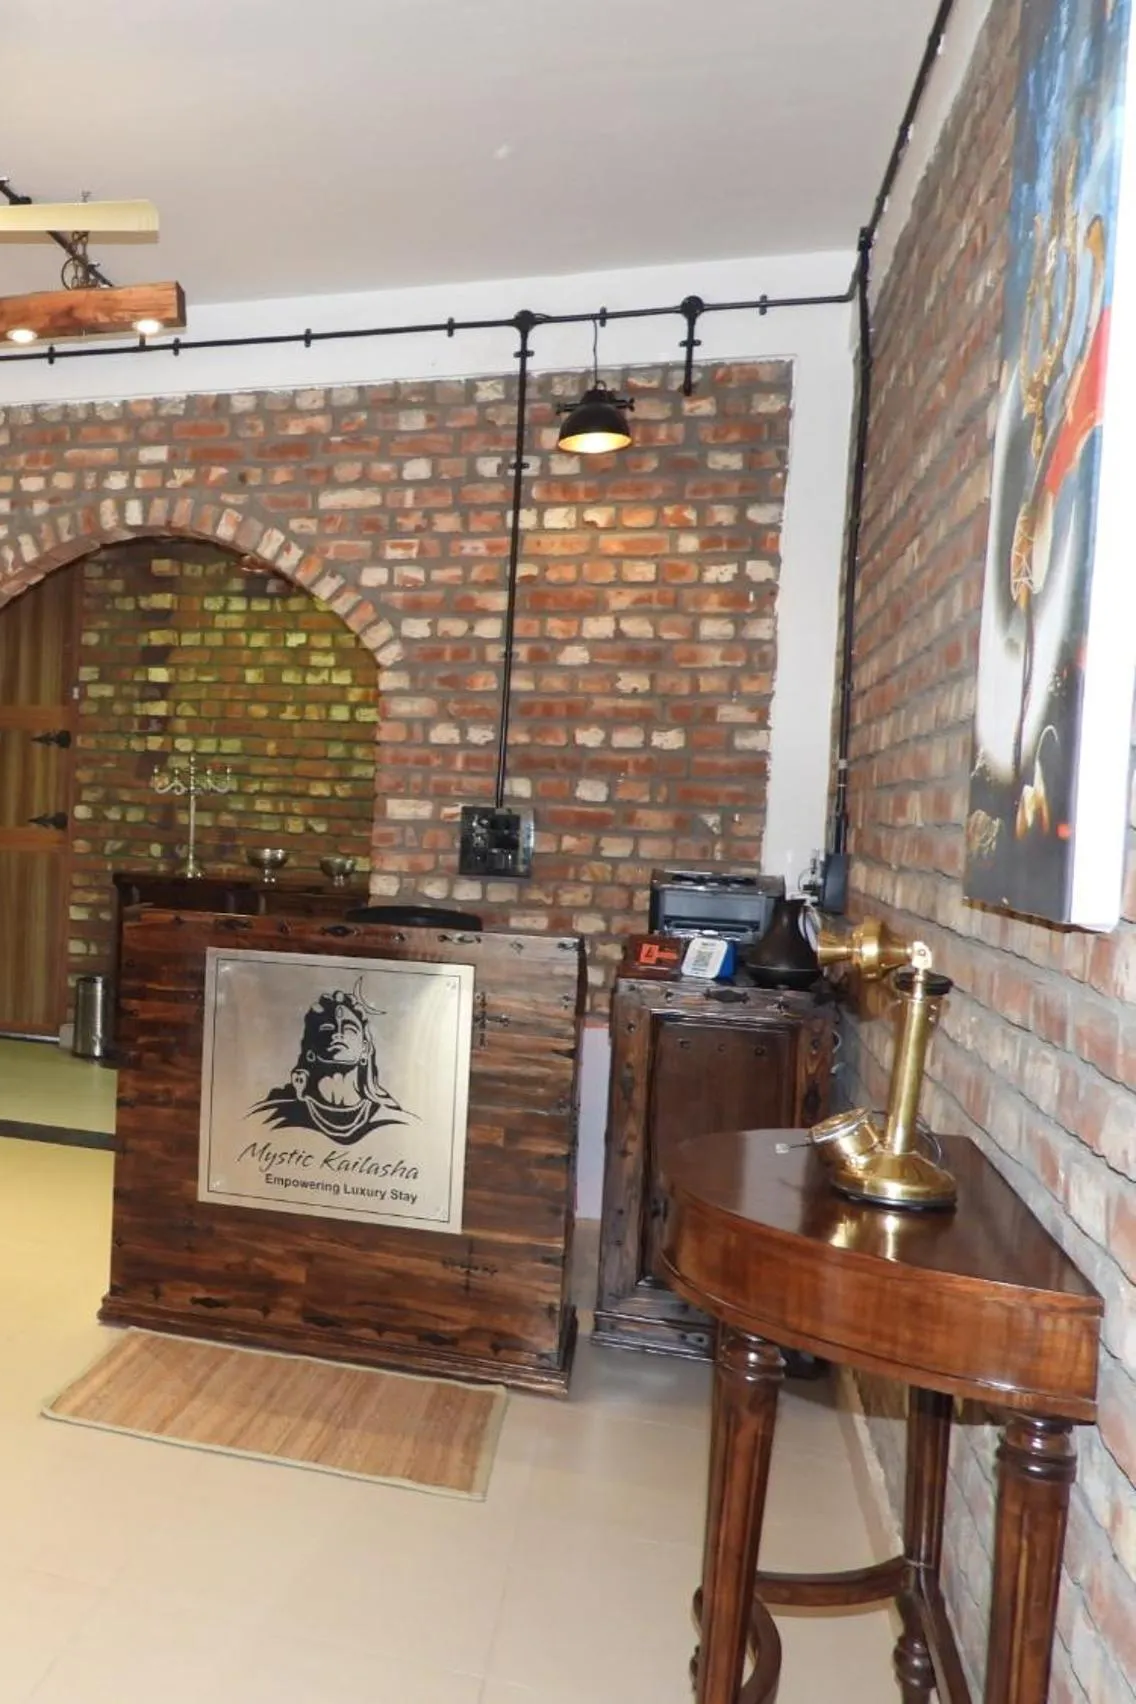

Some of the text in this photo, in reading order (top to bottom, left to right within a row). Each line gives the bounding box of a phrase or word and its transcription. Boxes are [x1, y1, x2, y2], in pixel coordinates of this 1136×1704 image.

[237, 1142, 419, 1180] Mystic Kailasha
[265, 1173, 418, 1204] Empowering Luxury Stay
